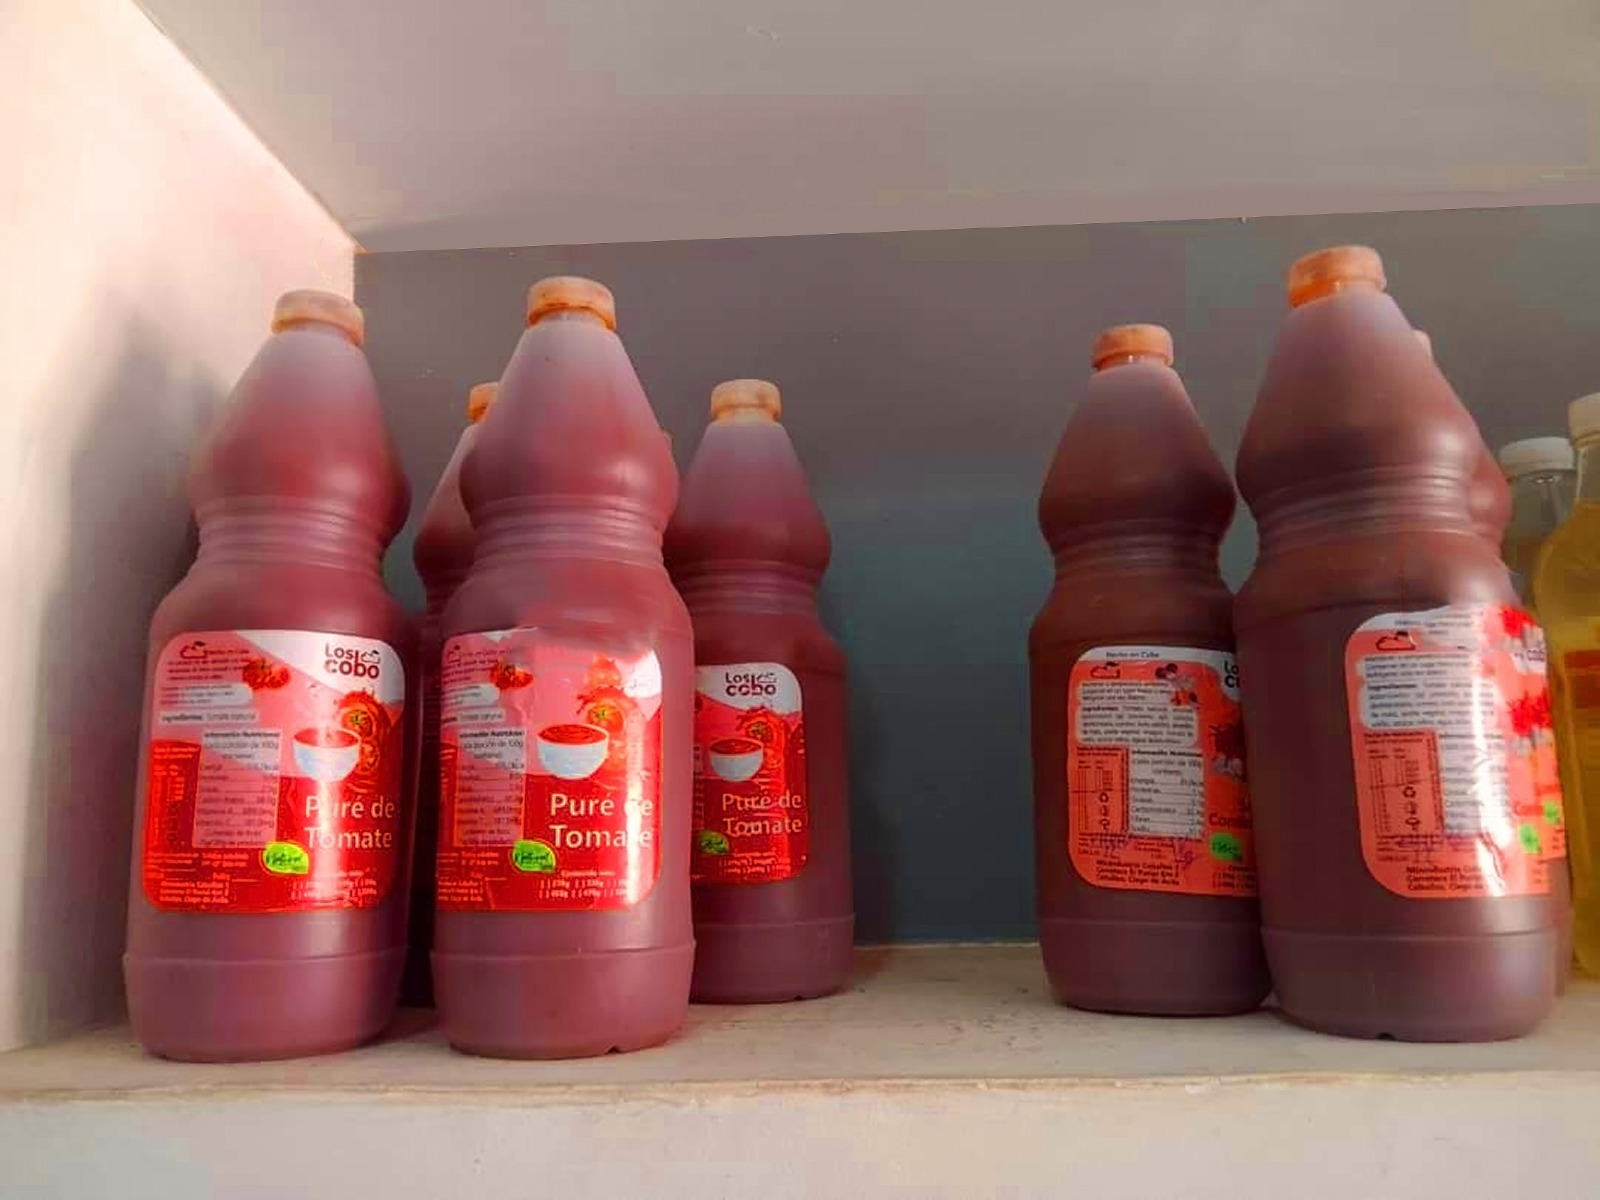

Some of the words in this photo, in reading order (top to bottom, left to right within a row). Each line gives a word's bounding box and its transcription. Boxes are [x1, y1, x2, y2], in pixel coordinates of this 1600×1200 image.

[325, 642, 354, 660] Los
[725, 672, 750, 684] Los
[1224, 660, 1240, 675] Lo
[370, 795, 396, 819] de
[550, 793, 616, 817] Puré
[779, 788, 803, 809] de
[304, 827, 393, 849] Tomate
[548, 824, 653, 848] Tomae
